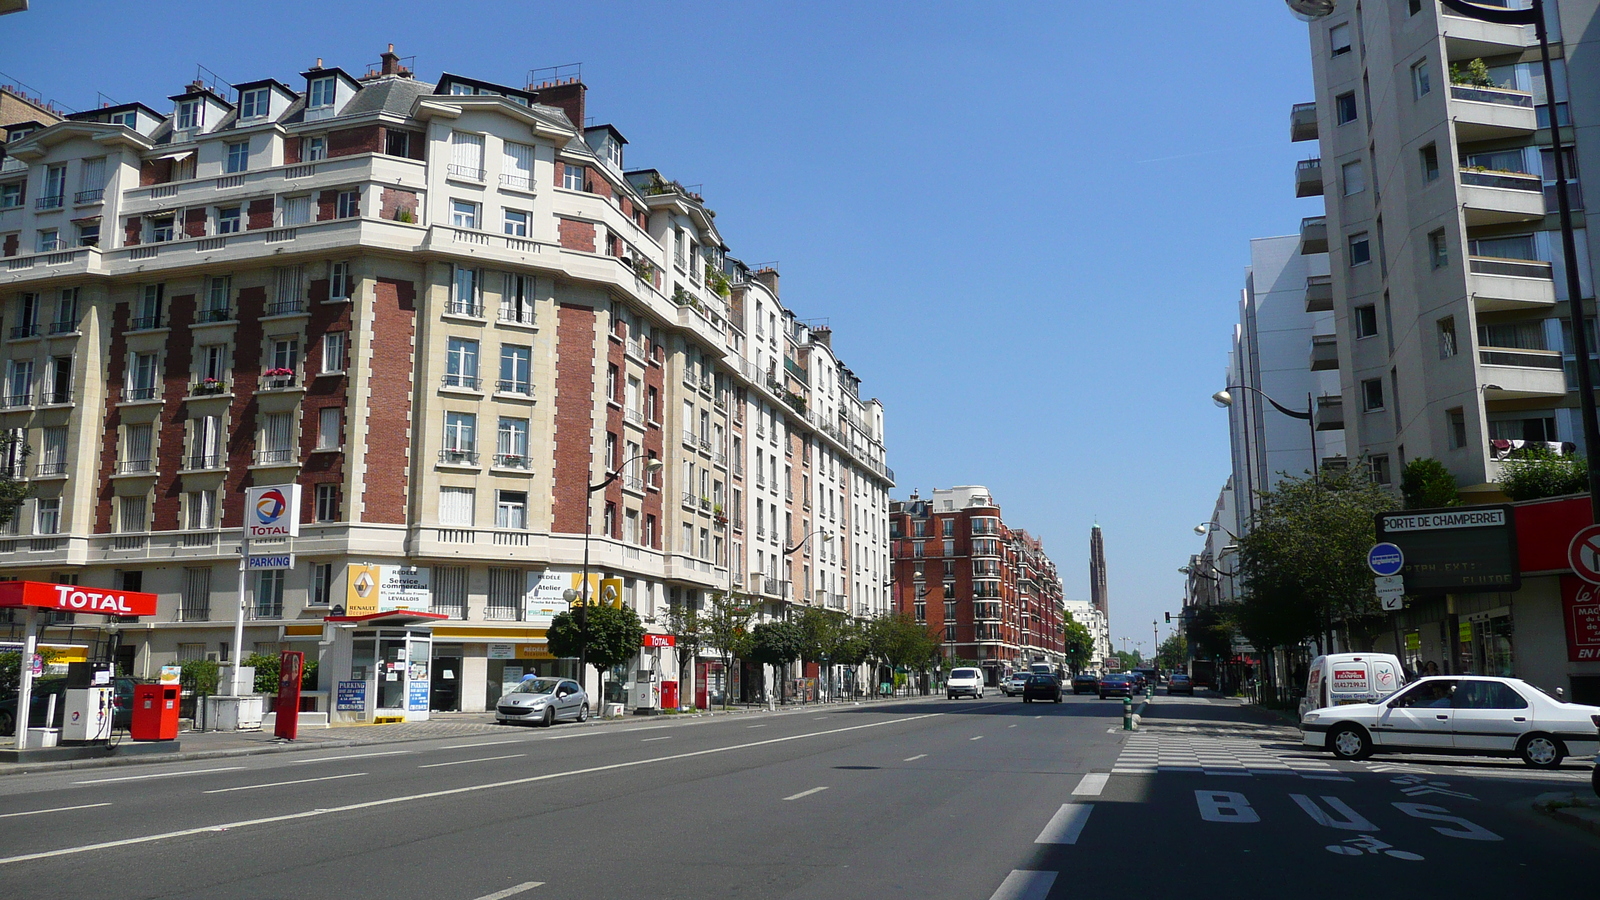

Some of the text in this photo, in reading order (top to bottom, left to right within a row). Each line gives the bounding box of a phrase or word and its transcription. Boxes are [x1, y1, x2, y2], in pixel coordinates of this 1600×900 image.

[1384, 511, 1503, 529] PORTE DE CHAMPERRET
[250, 526, 289, 535] TOTAL
[250, 557, 290, 567] PARKING
[55, 585, 132, 612] TOTAL
[651, 635, 669, 646] TOTAL
[1578, 649, 1593, 658] EN
[1194, 789, 1504, 841] BUS
